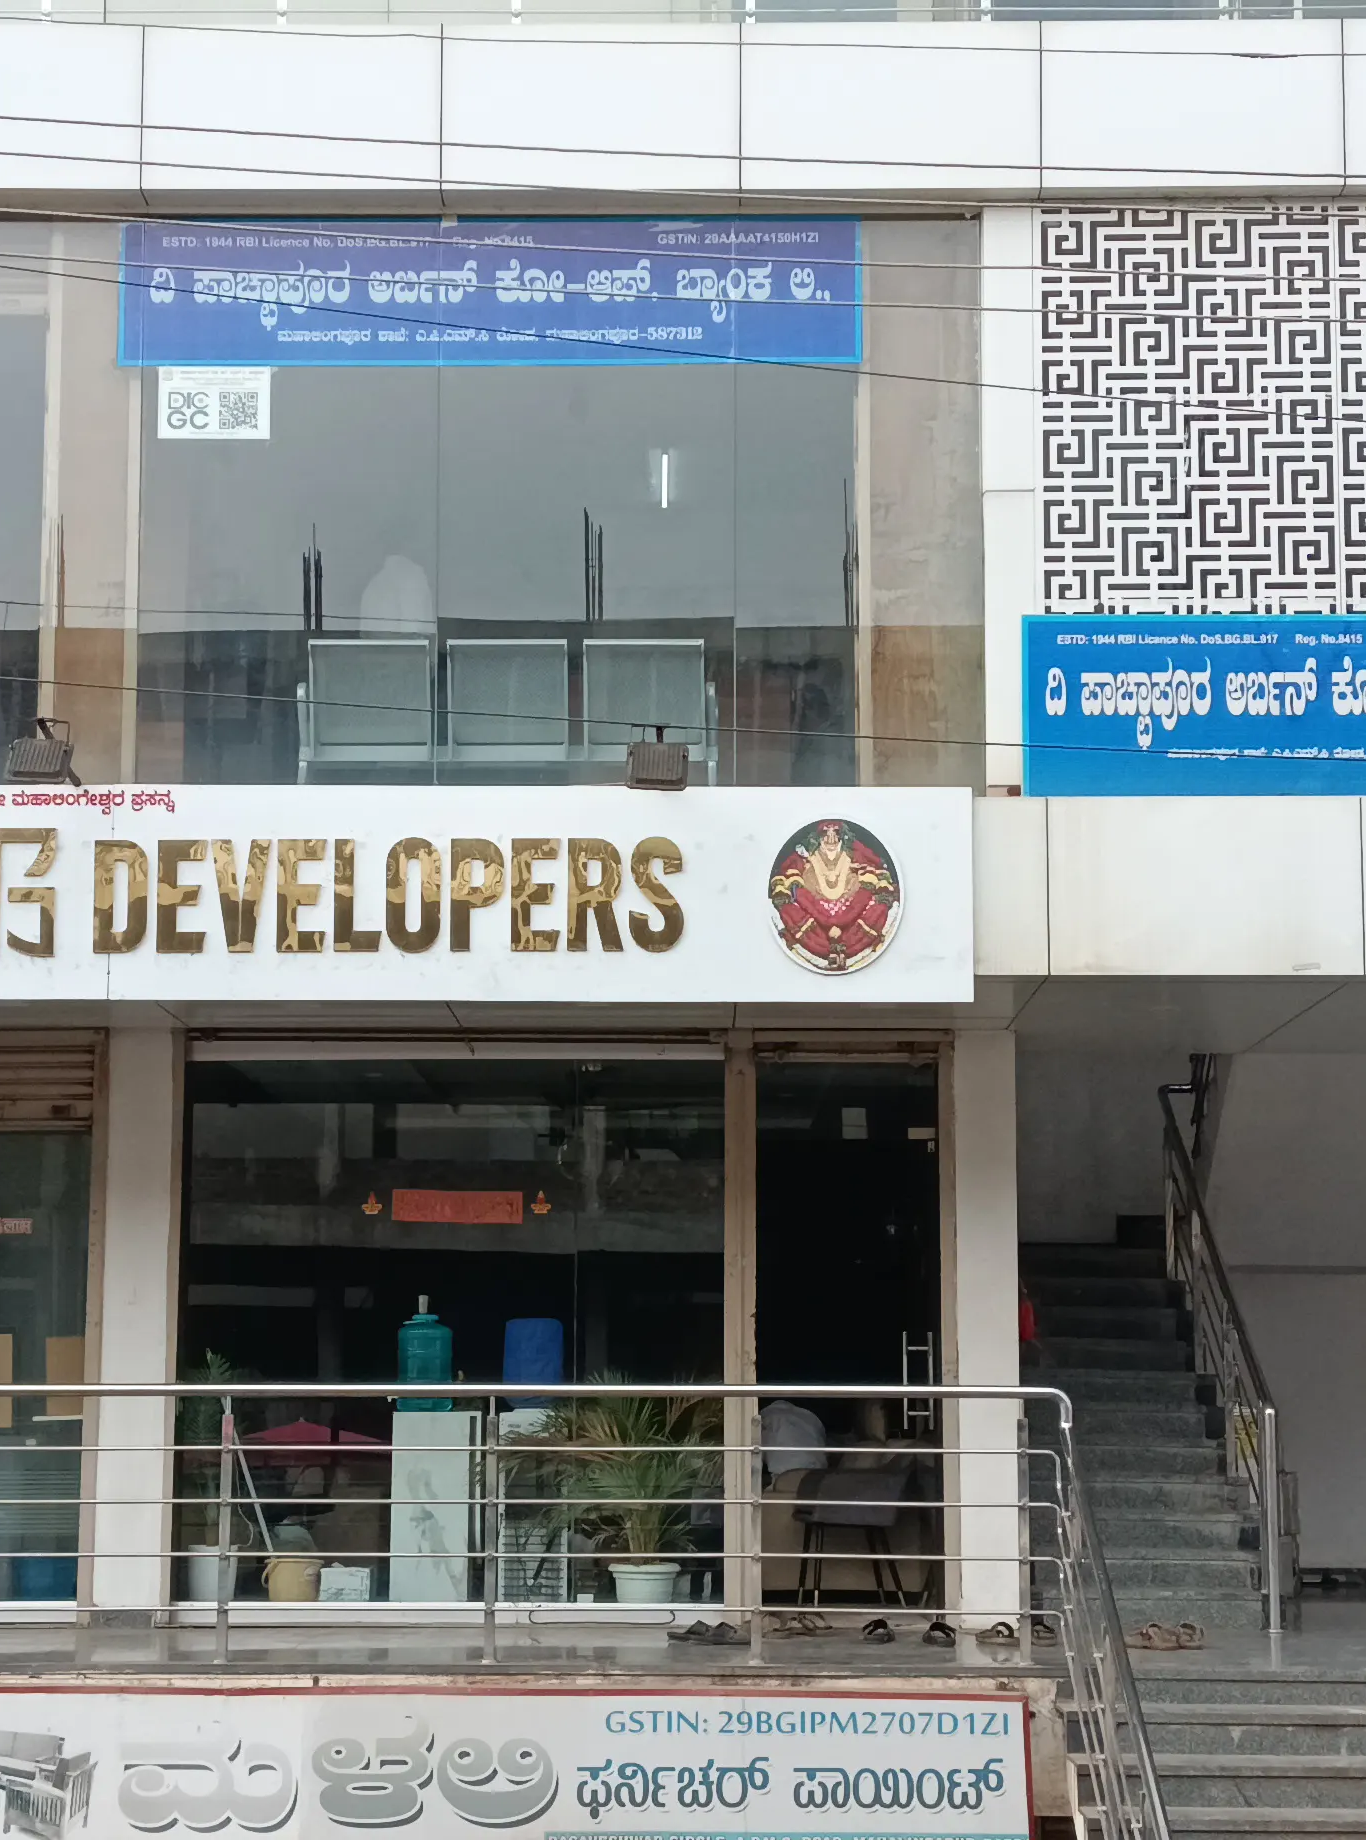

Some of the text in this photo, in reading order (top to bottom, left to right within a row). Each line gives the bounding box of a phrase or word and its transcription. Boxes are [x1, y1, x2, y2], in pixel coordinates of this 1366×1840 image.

[205, 235, 232, 248] 1944
[237, 235, 258, 248] RBI
[657, 233, 700, 246] GSTIN:
[149, 264, 175, 304] ದಿ
[368, 259, 478, 304] ಅರ್ಬನ್
[1091, 633, 1115, 645] 1944
[1118, 633, 1136, 645] RBI
[1045, 666, 1067, 716] ದಿ
[1225, 656, 1317, 716] ಅರ್ಬನ್
[11, 789, 125, 815] ಮಹಾಲಿಂಗೇಶ್ವರ
[131, 789, 176, 813] ಪ್ರಸನ್ನ
[92, 836, 685, 954] DEVELOPERS
[605, 1709, 1011, 1737] GSTIN: 29BGIPM2707D1ZI
[576, 1755, 1006, 1823] ಫರ್ನಿಚರ್ ಪಾಯಿಂಟ್
